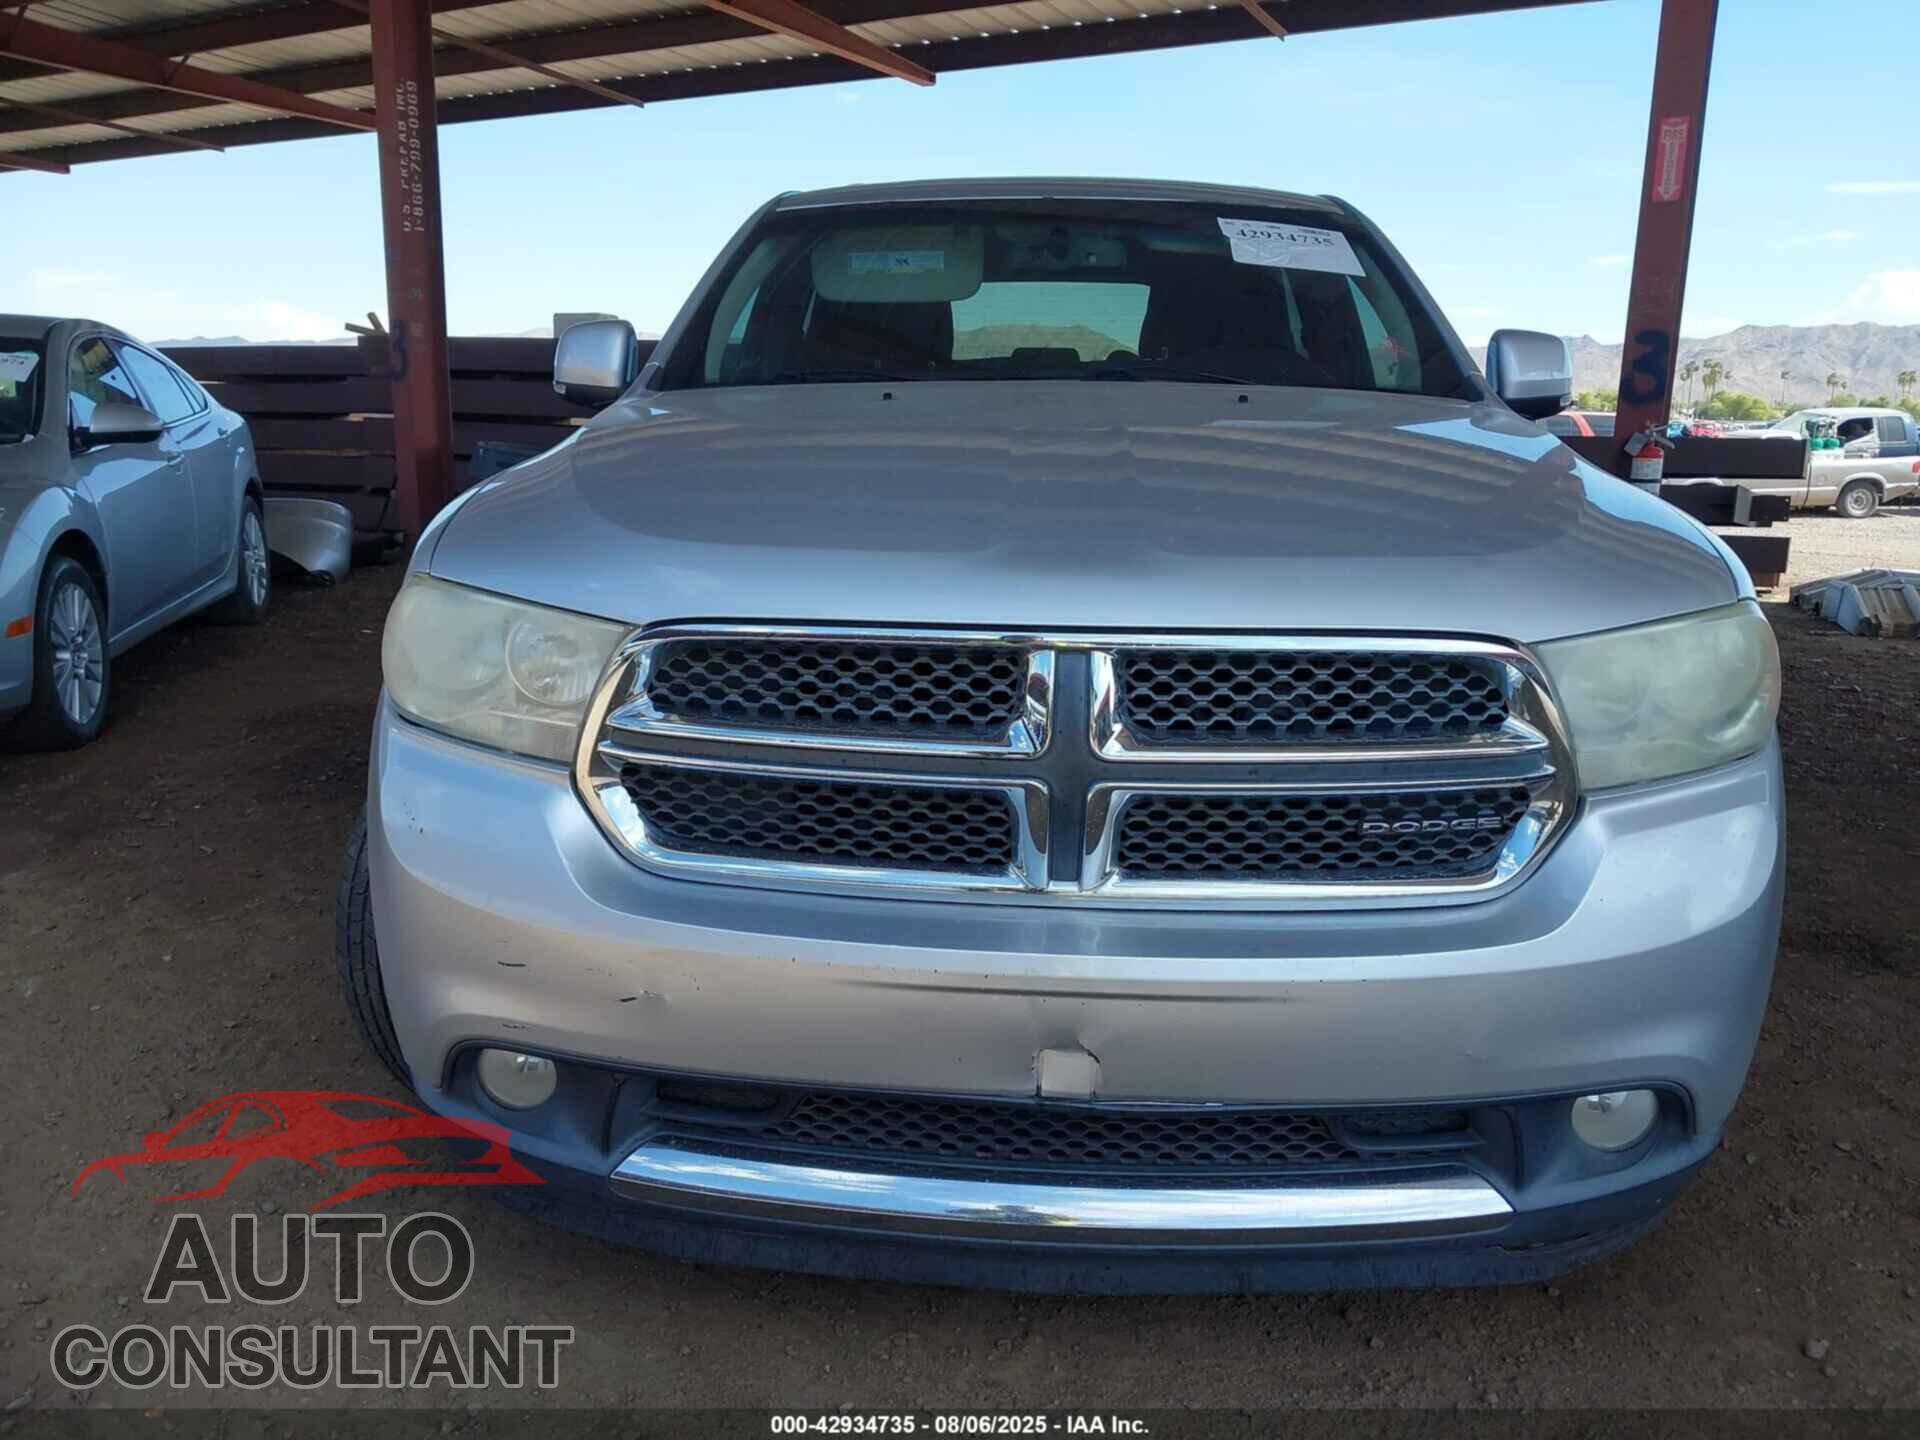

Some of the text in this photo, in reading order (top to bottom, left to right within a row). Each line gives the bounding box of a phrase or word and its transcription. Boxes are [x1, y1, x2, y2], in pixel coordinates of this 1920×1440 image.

[1236, 228, 1335, 248] 42934735
[1622, 327, 1670, 404] 3
[1361, 816, 1503, 833] DODGE
